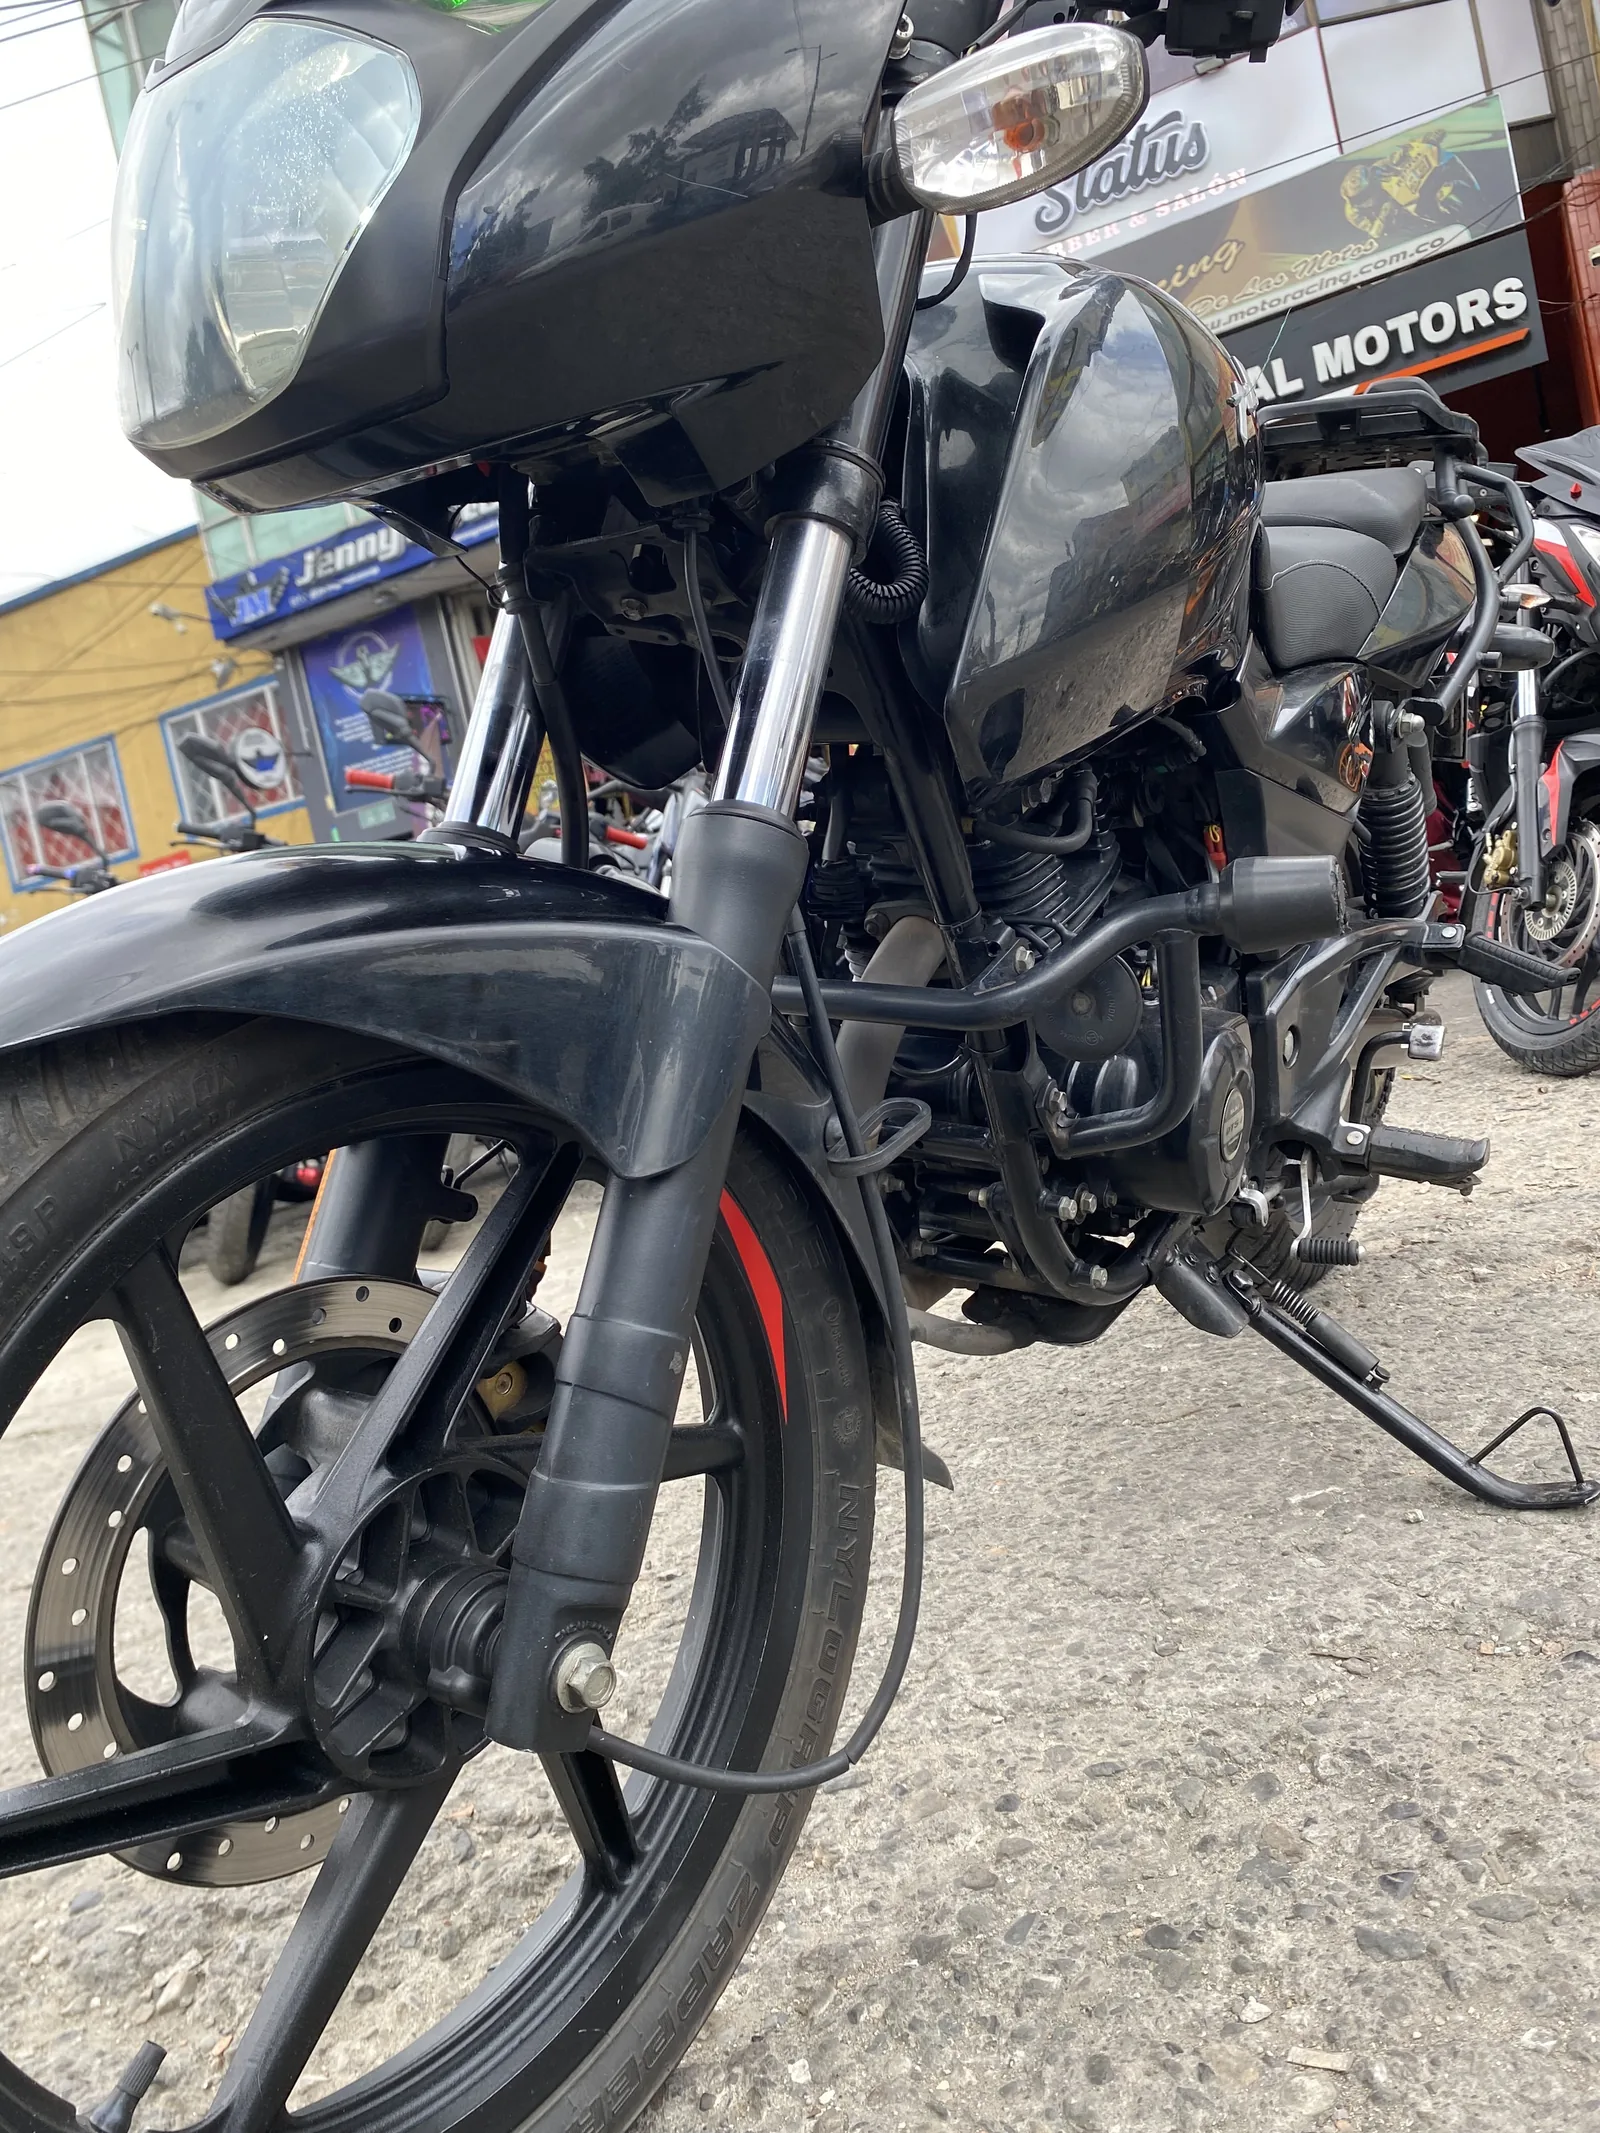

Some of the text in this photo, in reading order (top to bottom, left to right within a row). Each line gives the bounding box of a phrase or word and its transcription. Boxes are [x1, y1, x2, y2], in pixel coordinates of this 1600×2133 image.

[1034, 109, 1208, 235] Status
[1036, 167, 1248, 257] RBER & SALÓN
[1291, 238, 1379, 278] Motos
[1311, 277, 1528, 384] MOTORS
[768, 1483, 860, 1847] NYLOGRP
